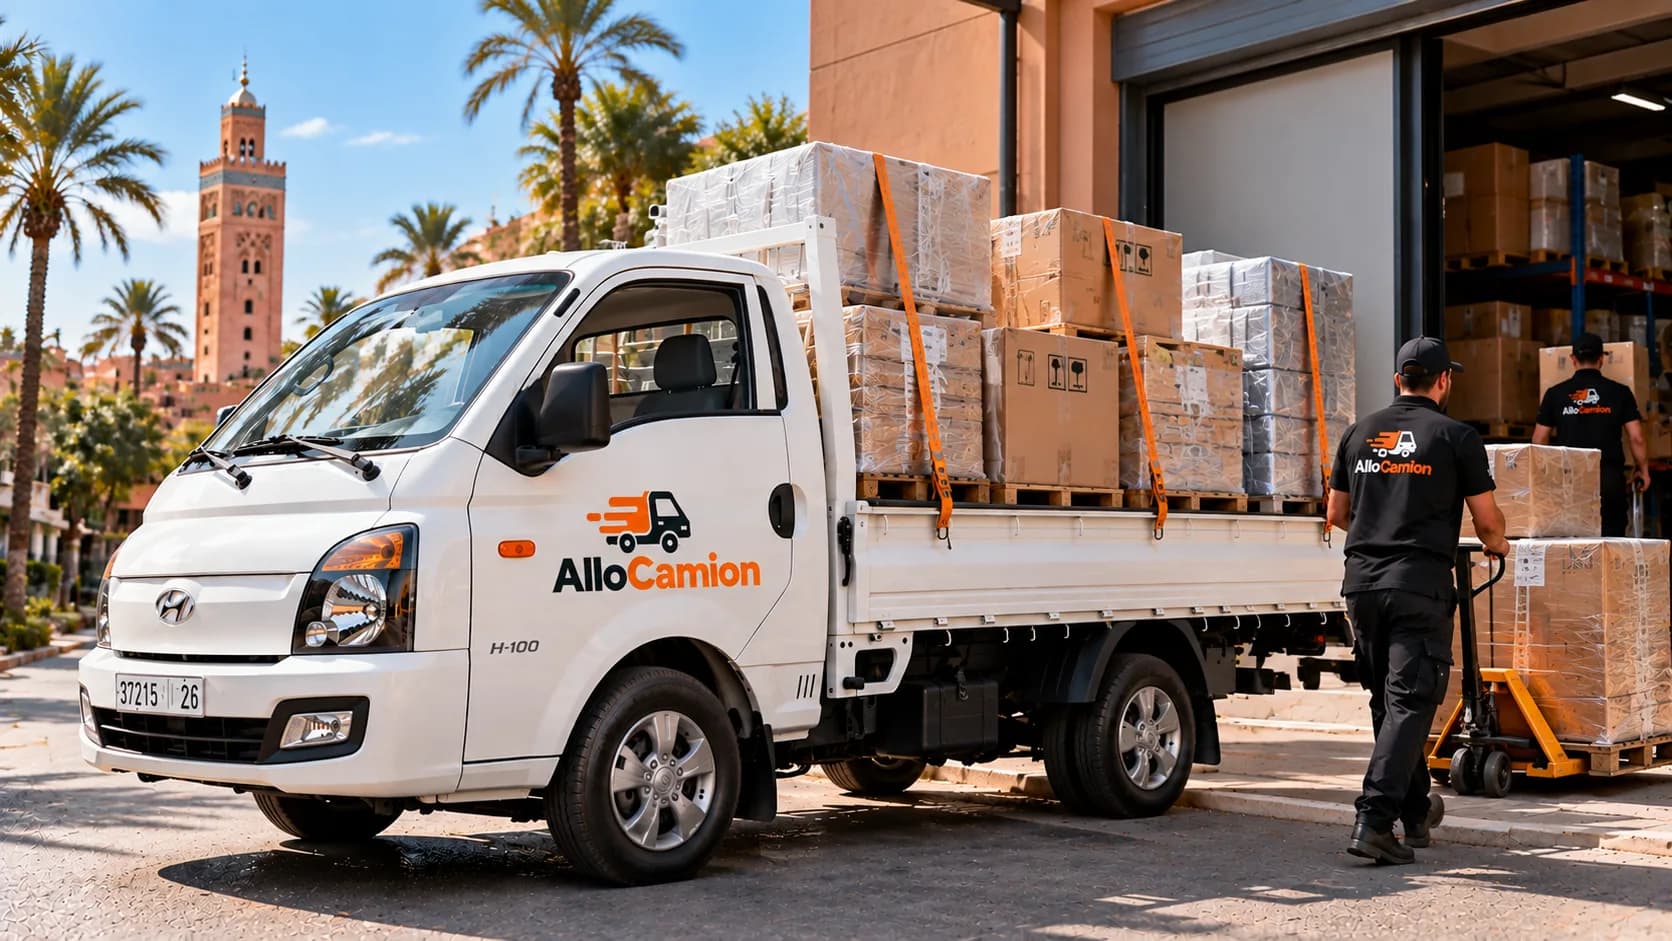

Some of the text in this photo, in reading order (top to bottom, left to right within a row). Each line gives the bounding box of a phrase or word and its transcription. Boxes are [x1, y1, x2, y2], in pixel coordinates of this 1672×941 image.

[1354, 459, 1432, 476] AlloCamion
[552, 551, 761, 593] AlloCamion
[490, 640, 540, 655] H-100
[120, 680, 199, 709] 37215 26
